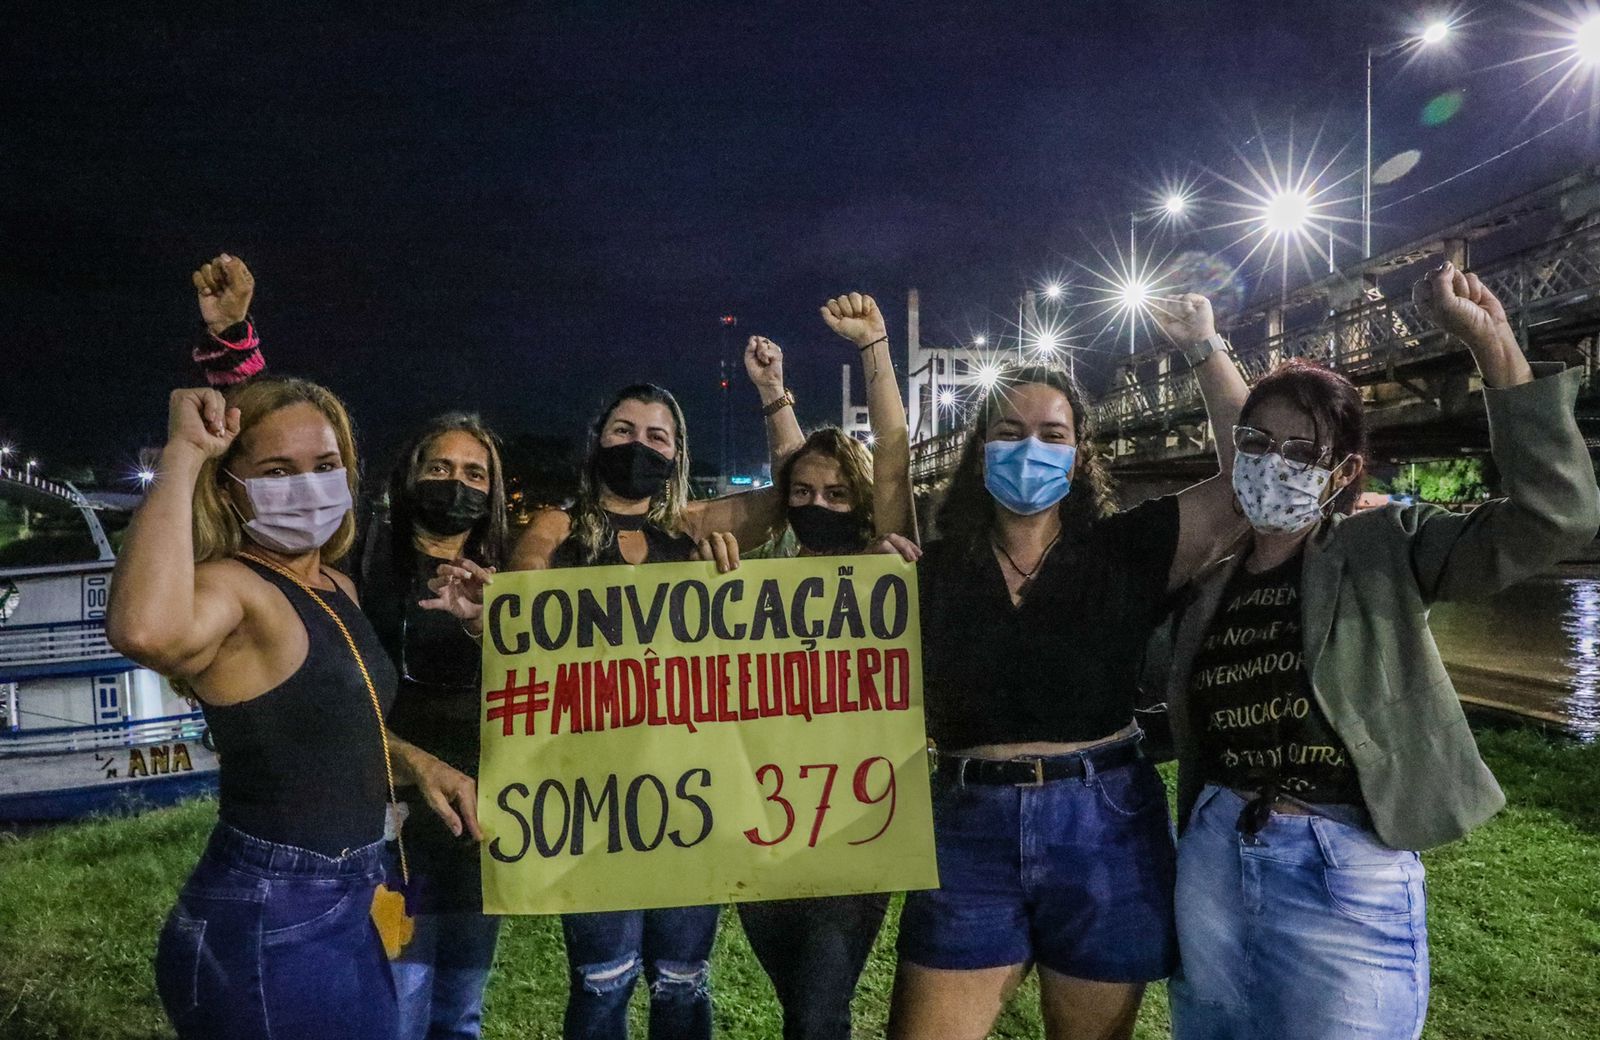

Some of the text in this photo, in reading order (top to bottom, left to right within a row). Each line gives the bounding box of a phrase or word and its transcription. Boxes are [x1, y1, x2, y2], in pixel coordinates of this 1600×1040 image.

[488, 565, 909, 655] CONVOCAÇÃO
[486, 647, 910, 736] #MIMDÊQUEEUQUERO
[127, 743, 193, 778] ANA
[488, 756, 897, 863] SOMOS 379
